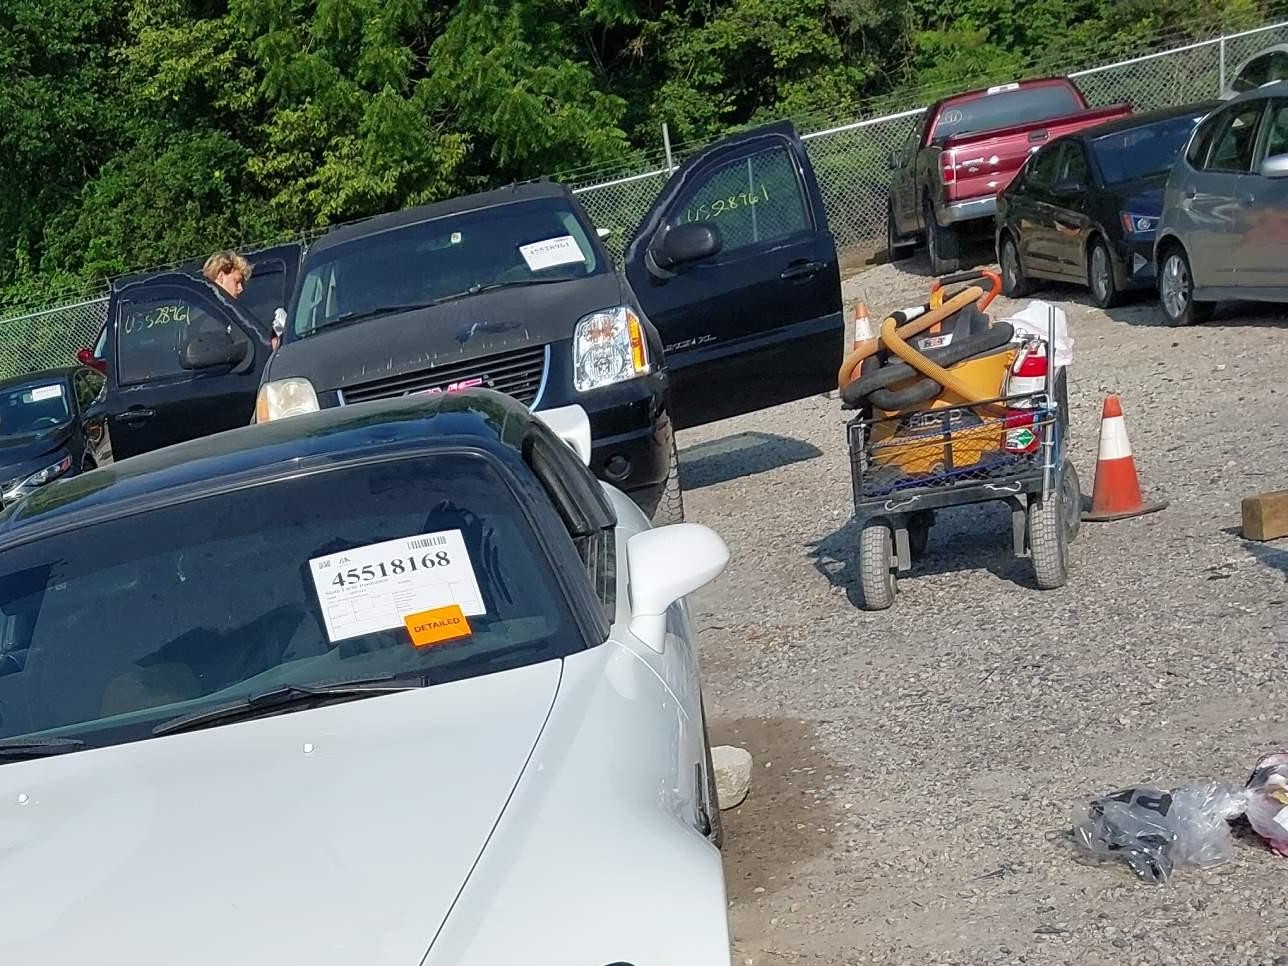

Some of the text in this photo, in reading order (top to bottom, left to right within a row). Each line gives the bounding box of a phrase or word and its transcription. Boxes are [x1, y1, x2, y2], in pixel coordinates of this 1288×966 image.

[909, 409, 962, 428] RIDGD
[331, 550, 451, 587] 45518168
[413, 616, 461, 633] DETAILED
